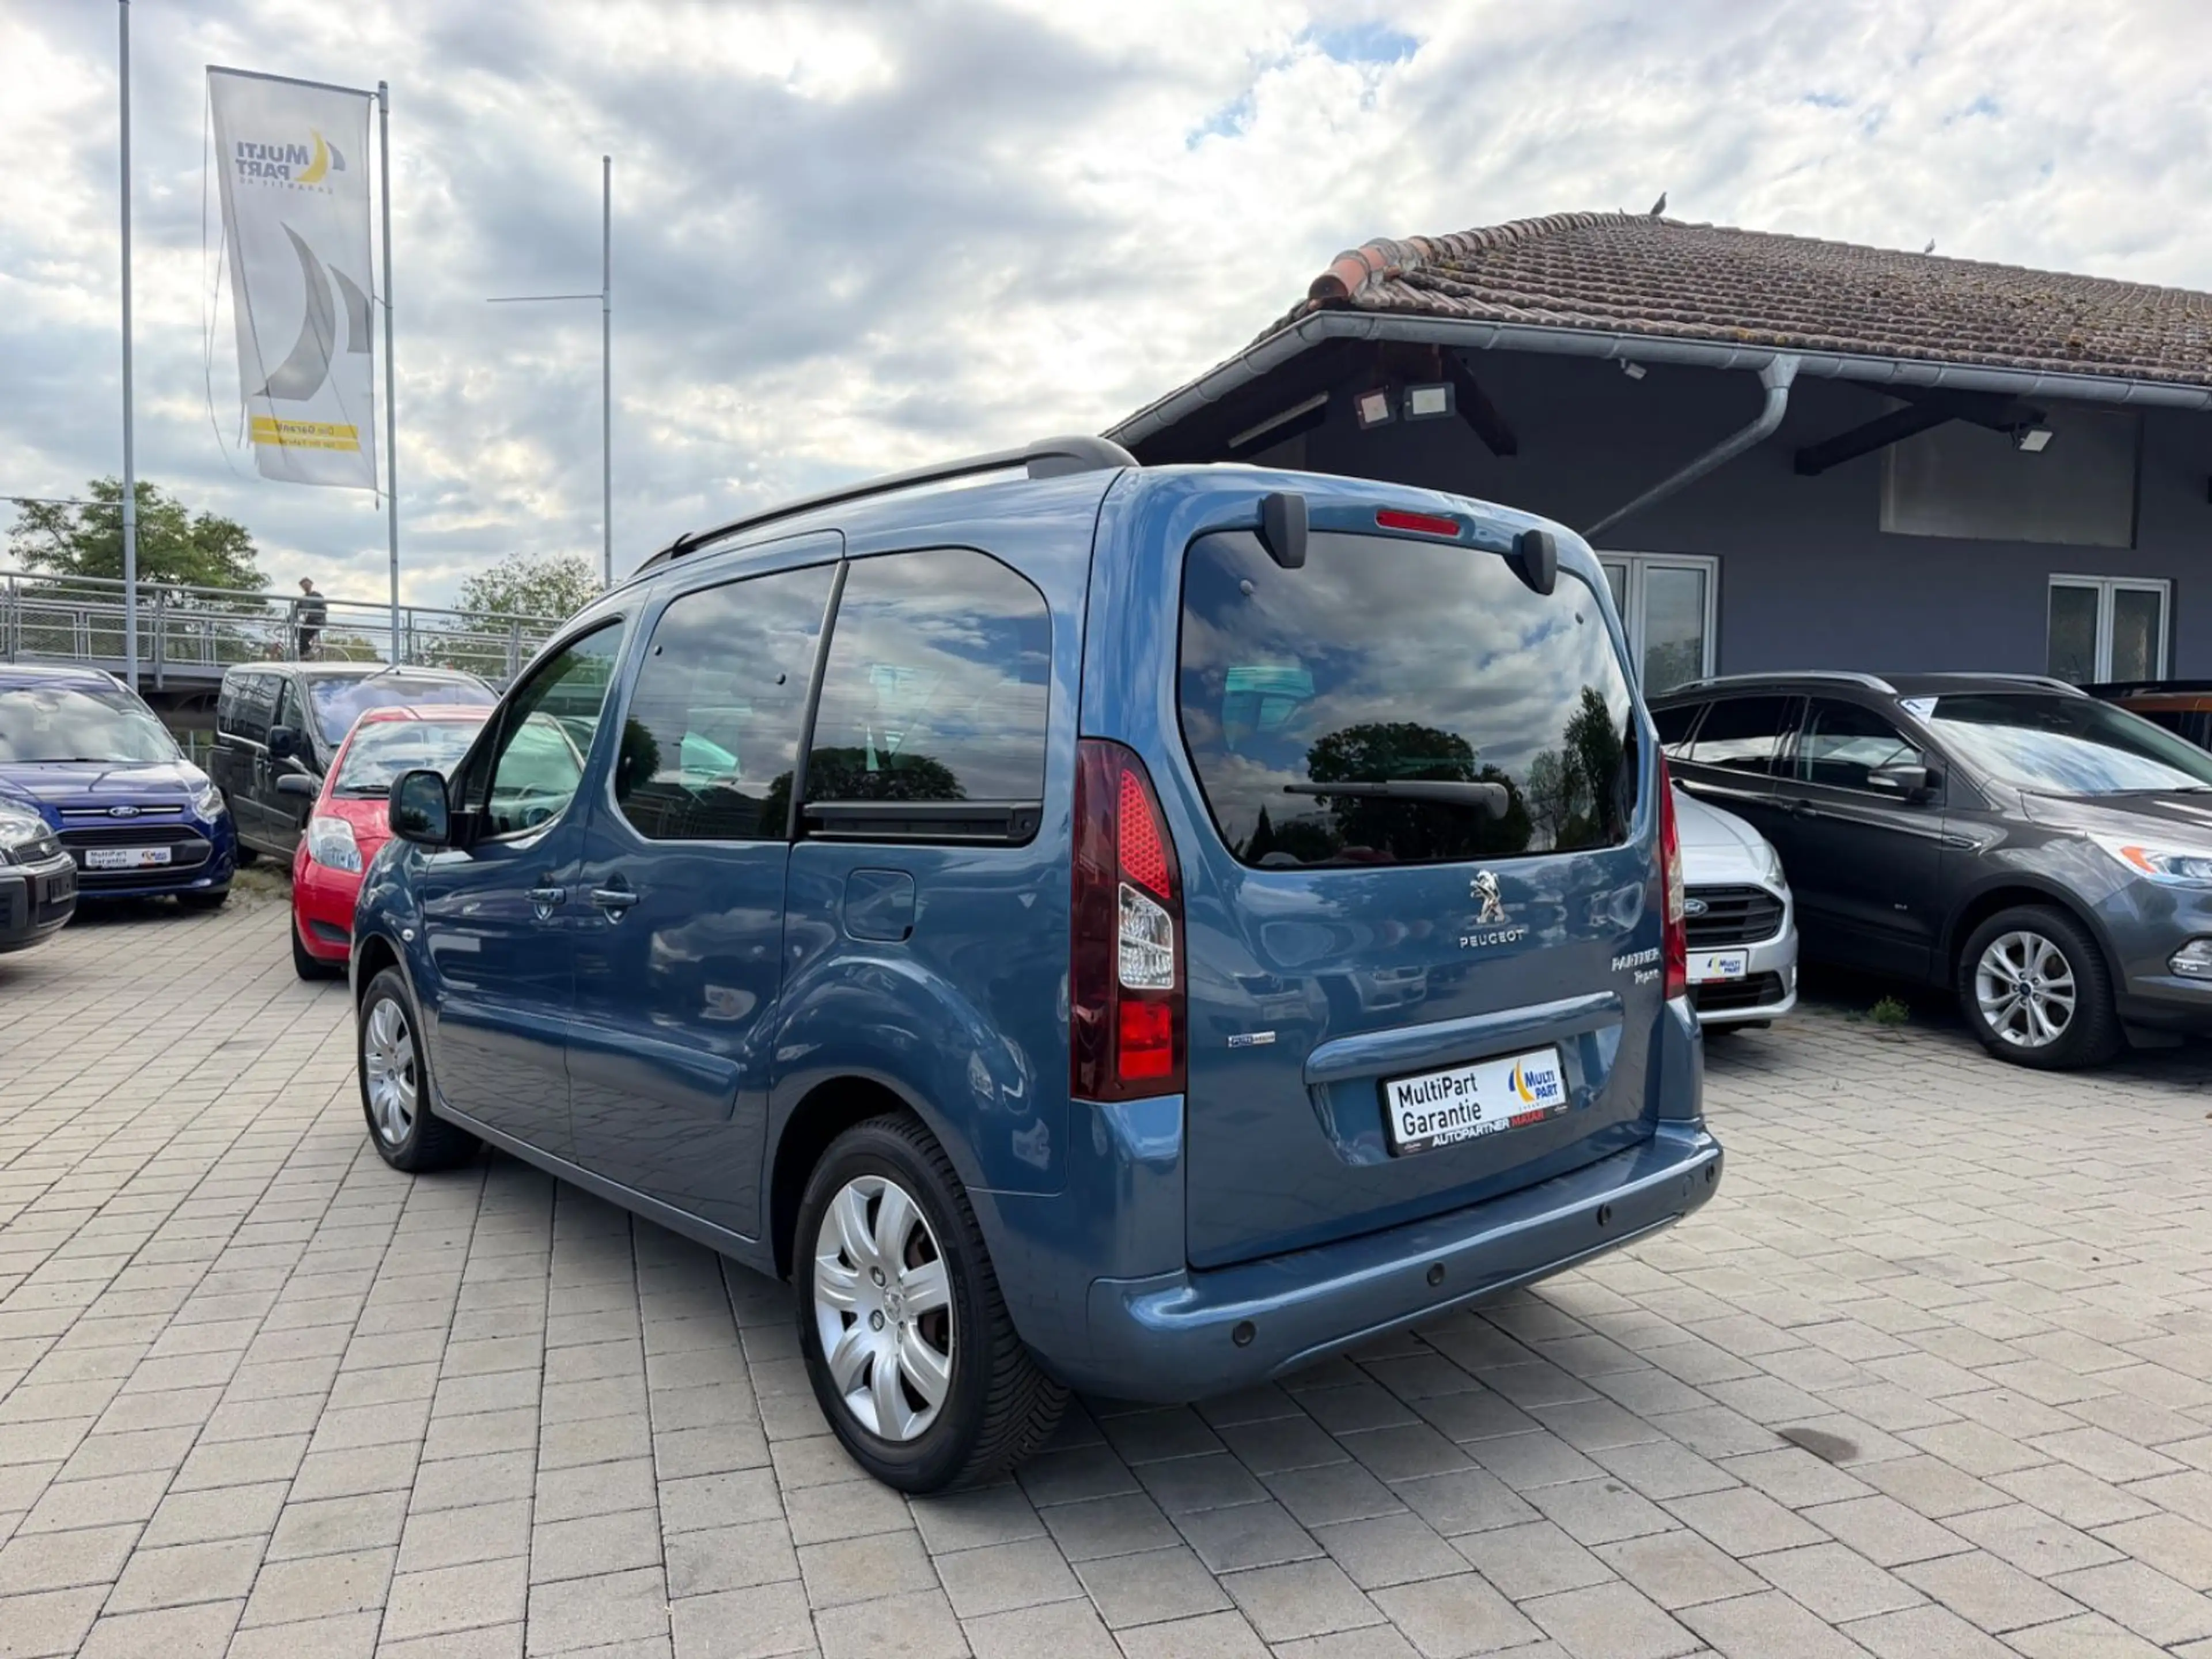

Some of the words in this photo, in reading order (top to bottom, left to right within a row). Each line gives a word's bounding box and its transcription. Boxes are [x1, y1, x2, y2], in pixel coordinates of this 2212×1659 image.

[1459, 929, 1525, 949] PEUGEOT
[1397, 1073, 1478, 1108] MultiPart
[1524, 1070, 1555, 1088] MULTI
[1535, 1084, 1558, 1099] PART
[1402, 1100, 1482, 1137] Garantie
[1432, 1118, 1510, 1147] AUTOPARTNER
